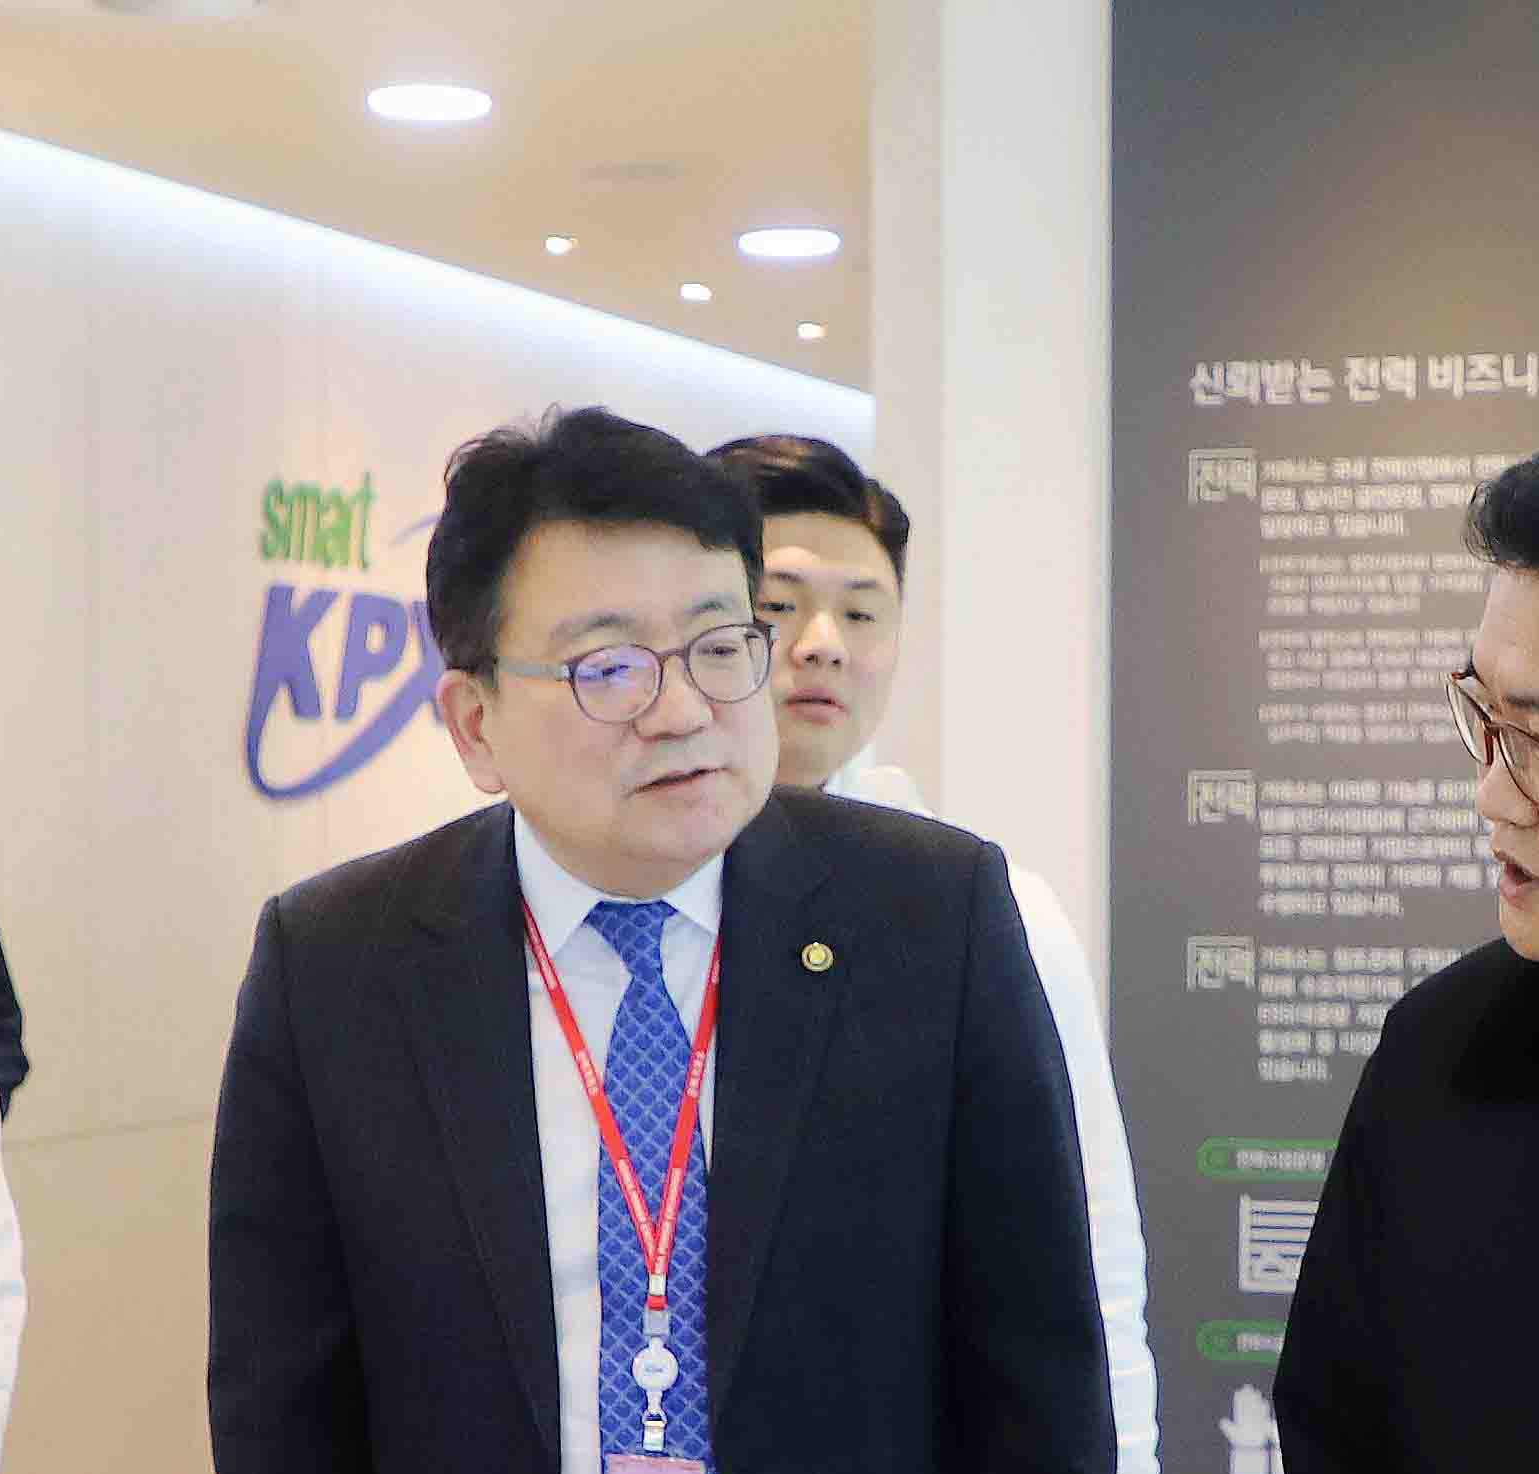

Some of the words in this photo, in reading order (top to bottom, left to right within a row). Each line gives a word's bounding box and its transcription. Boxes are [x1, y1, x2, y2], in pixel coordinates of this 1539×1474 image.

[1189, 357, 1334, 406] 신뢰받는
[1343, 353, 1418, 402] 전력
[261, 470, 375, 572] smart
